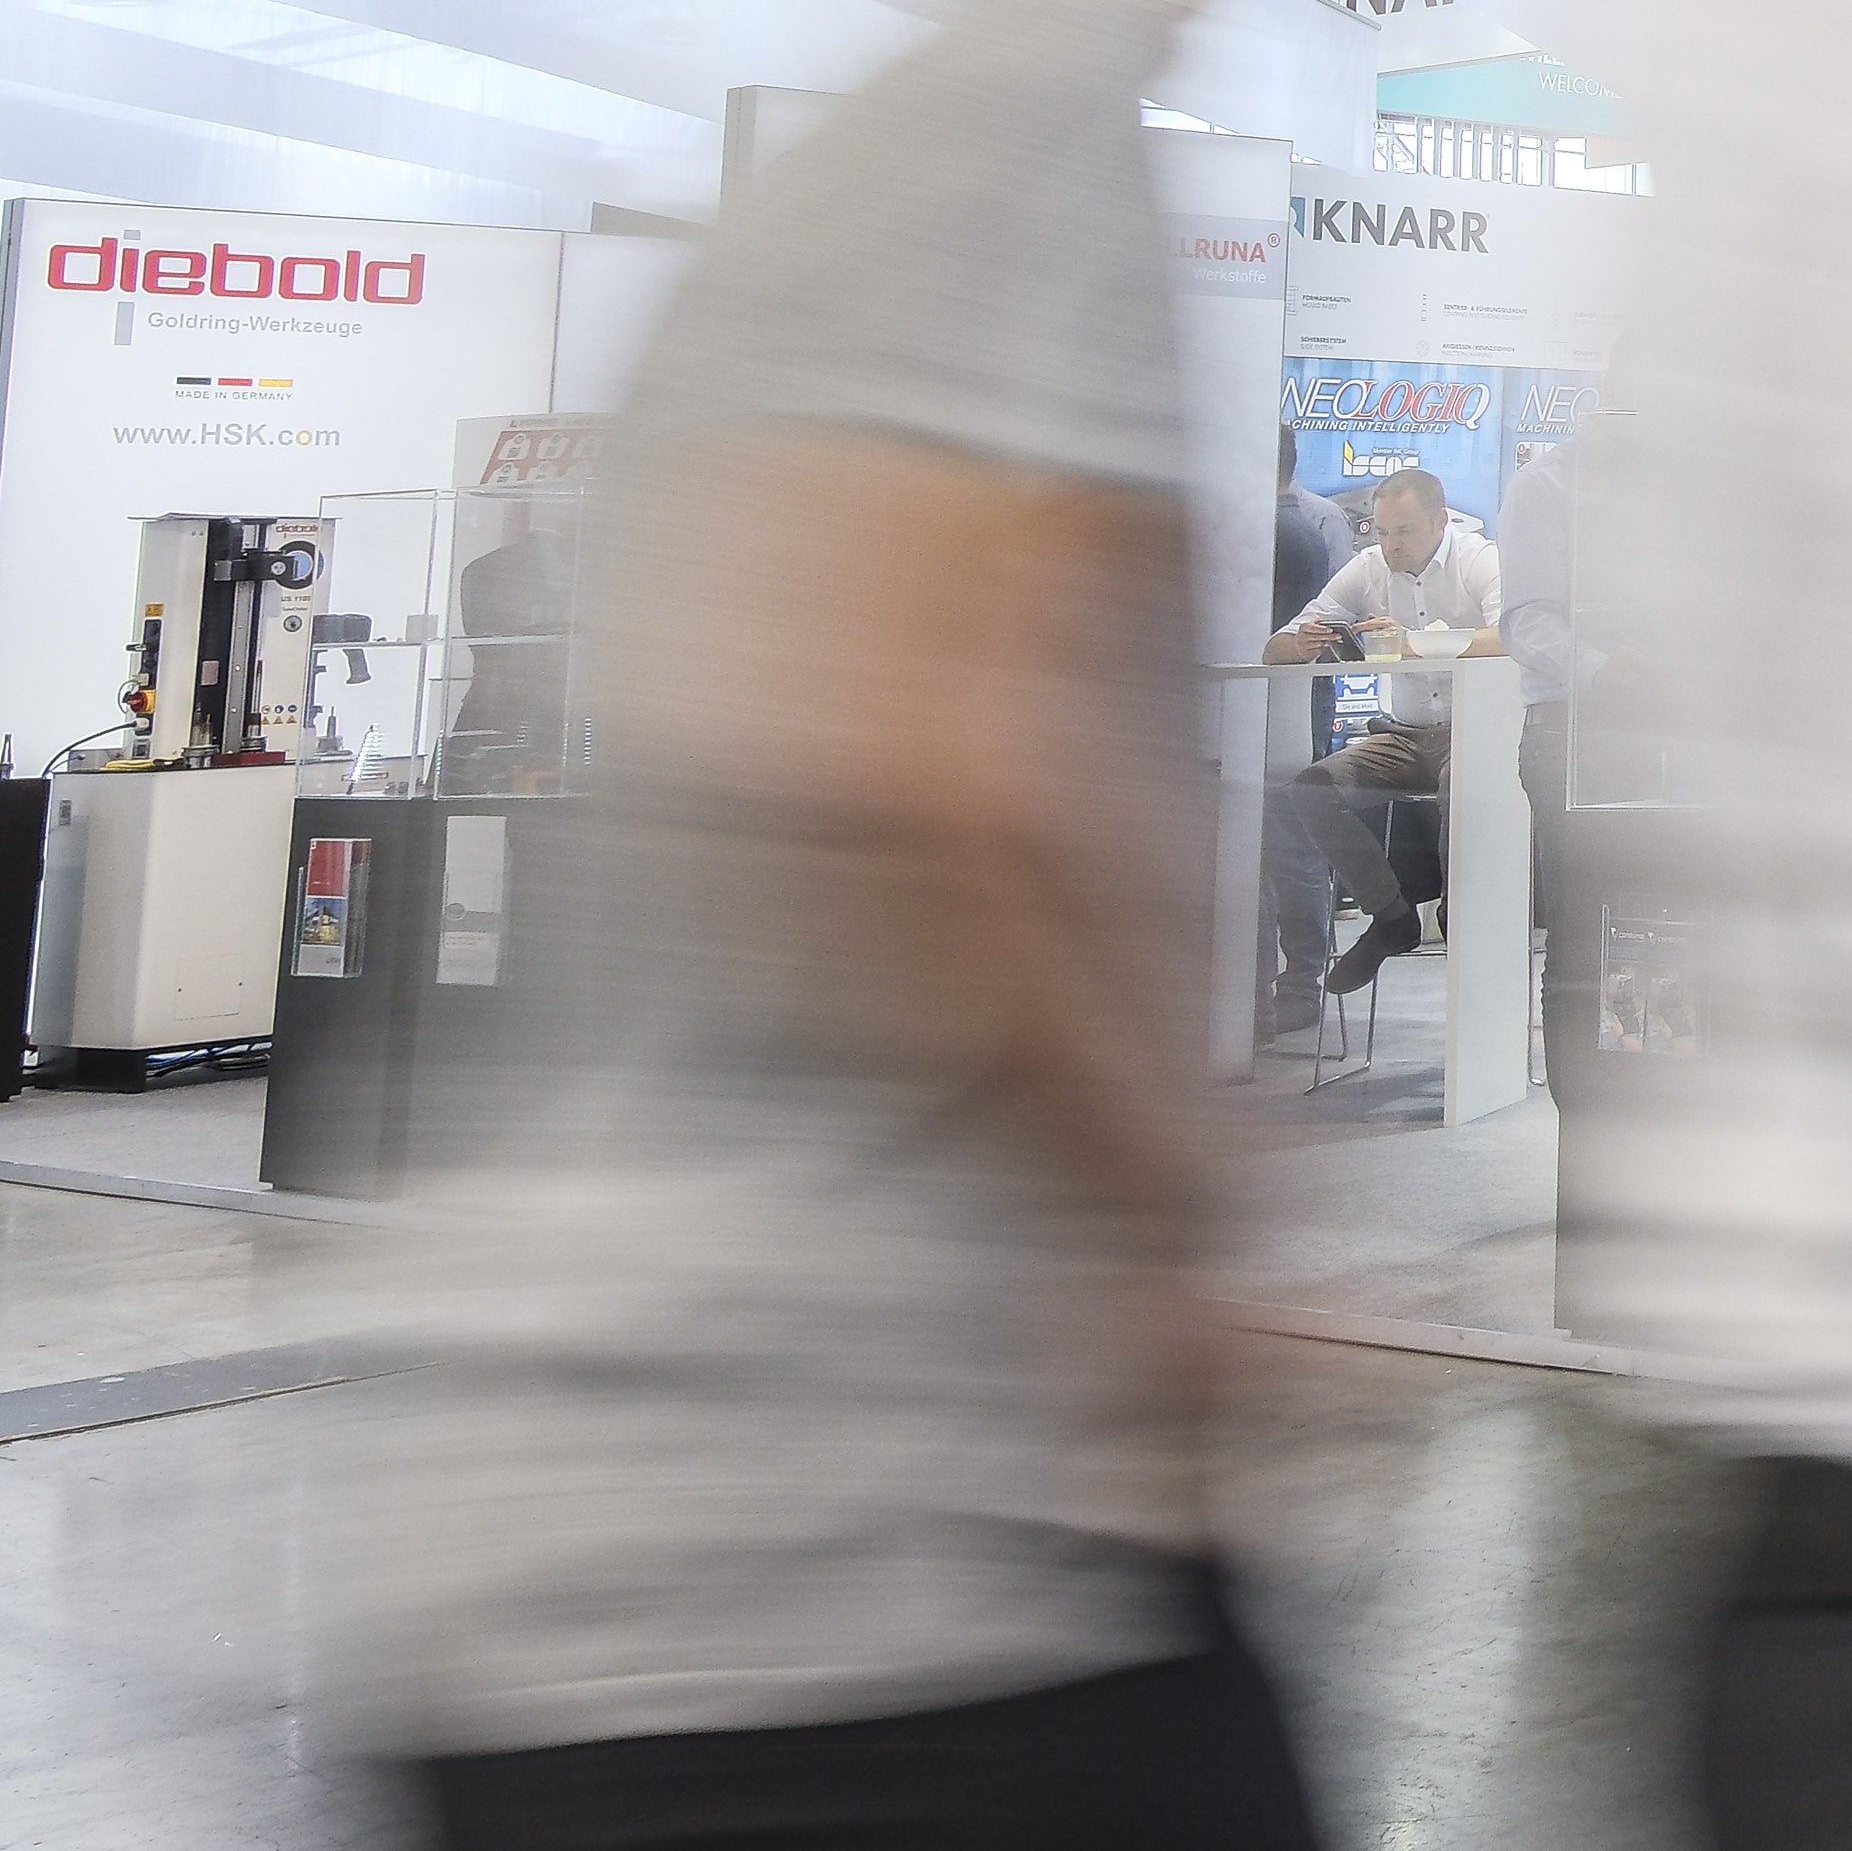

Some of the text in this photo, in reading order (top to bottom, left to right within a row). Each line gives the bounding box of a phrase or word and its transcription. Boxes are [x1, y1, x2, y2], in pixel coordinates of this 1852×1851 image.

[47, 230, 426, 306] diebold
[1193, 267, 1267, 284] Werkstoffe
[147, 311, 364, 337] Goldring-Werkzeuge
[175, 390, 293, 401] MADE IN GERMANY
[113, 422, 341, 447] www.HSK.com
[1288, 420, 1450, 434] CHINING INTELLIGENTLY
